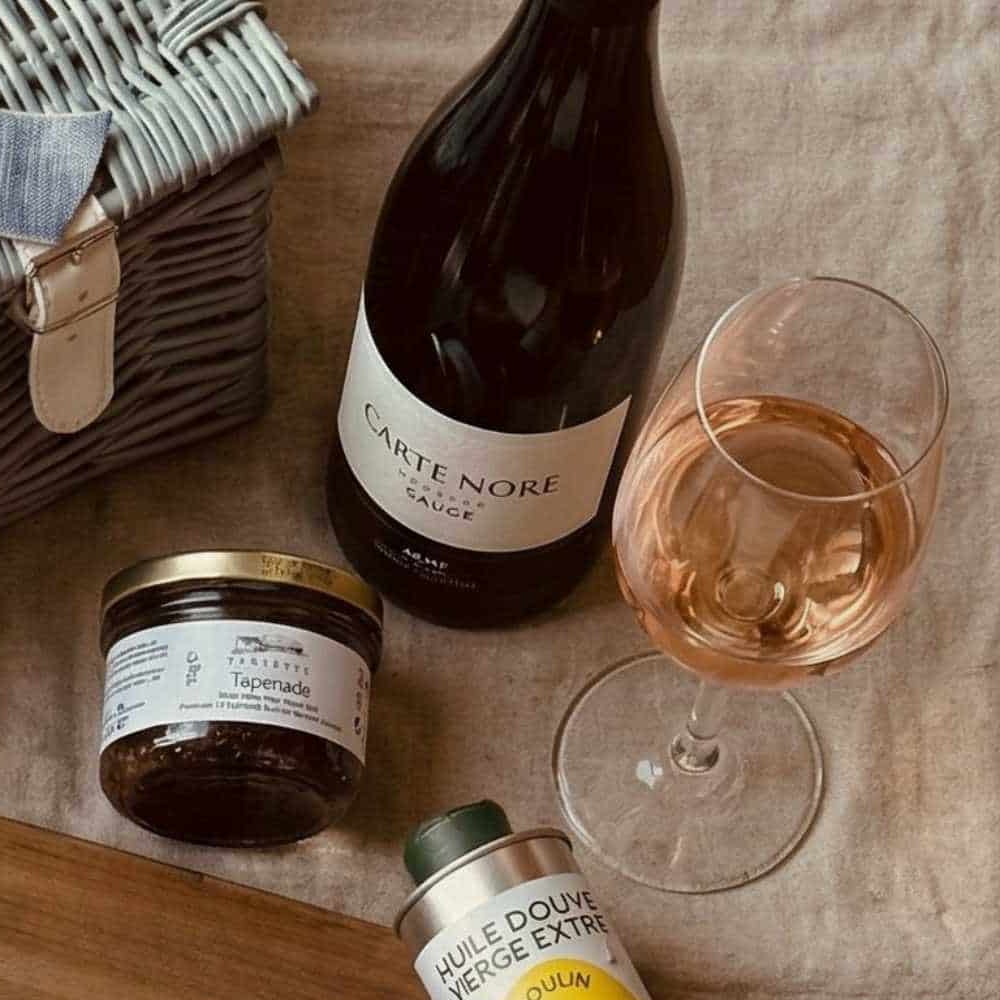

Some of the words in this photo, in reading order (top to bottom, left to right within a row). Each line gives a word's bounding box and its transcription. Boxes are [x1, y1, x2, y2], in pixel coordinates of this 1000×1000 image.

[364, 403, 448, 485] CARTE
[459, 473, 560, 498] NORE
[231, 672, 311, 698] Tapenade
[435, 921, 503, 985] HUILE
